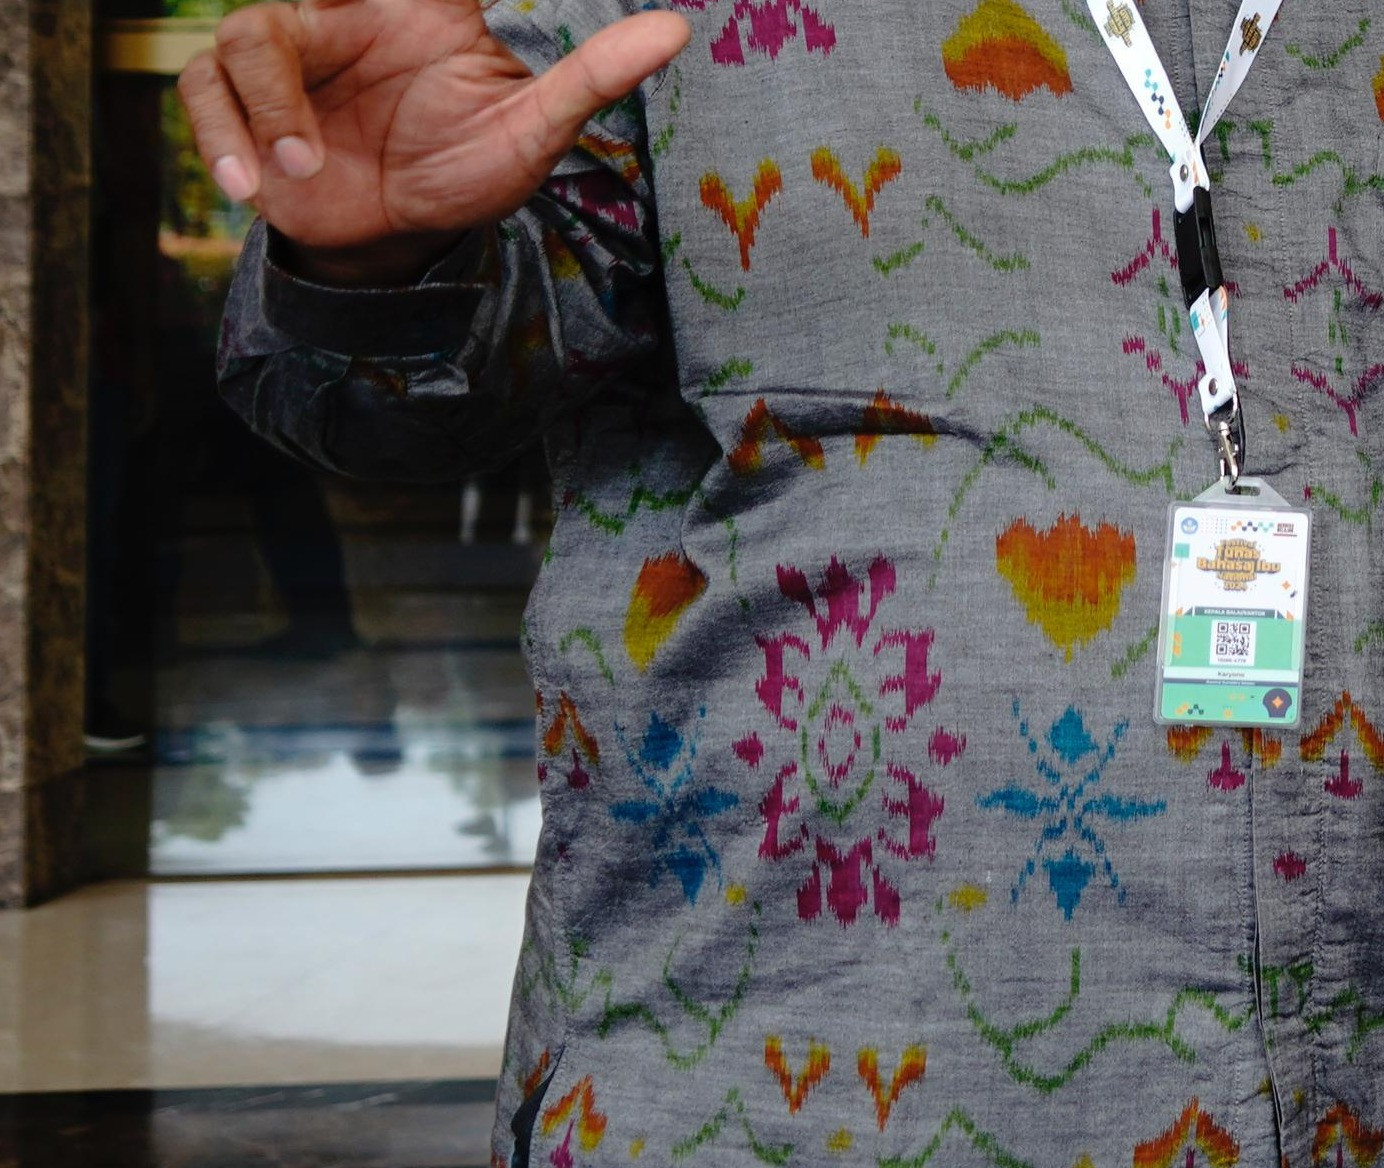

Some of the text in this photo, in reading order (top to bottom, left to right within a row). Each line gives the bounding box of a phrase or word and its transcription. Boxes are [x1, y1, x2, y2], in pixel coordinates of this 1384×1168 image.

[1217, 545, 1260, 561] Tunas
[1197, 557, 1281, 574] Bahasa Ibu
